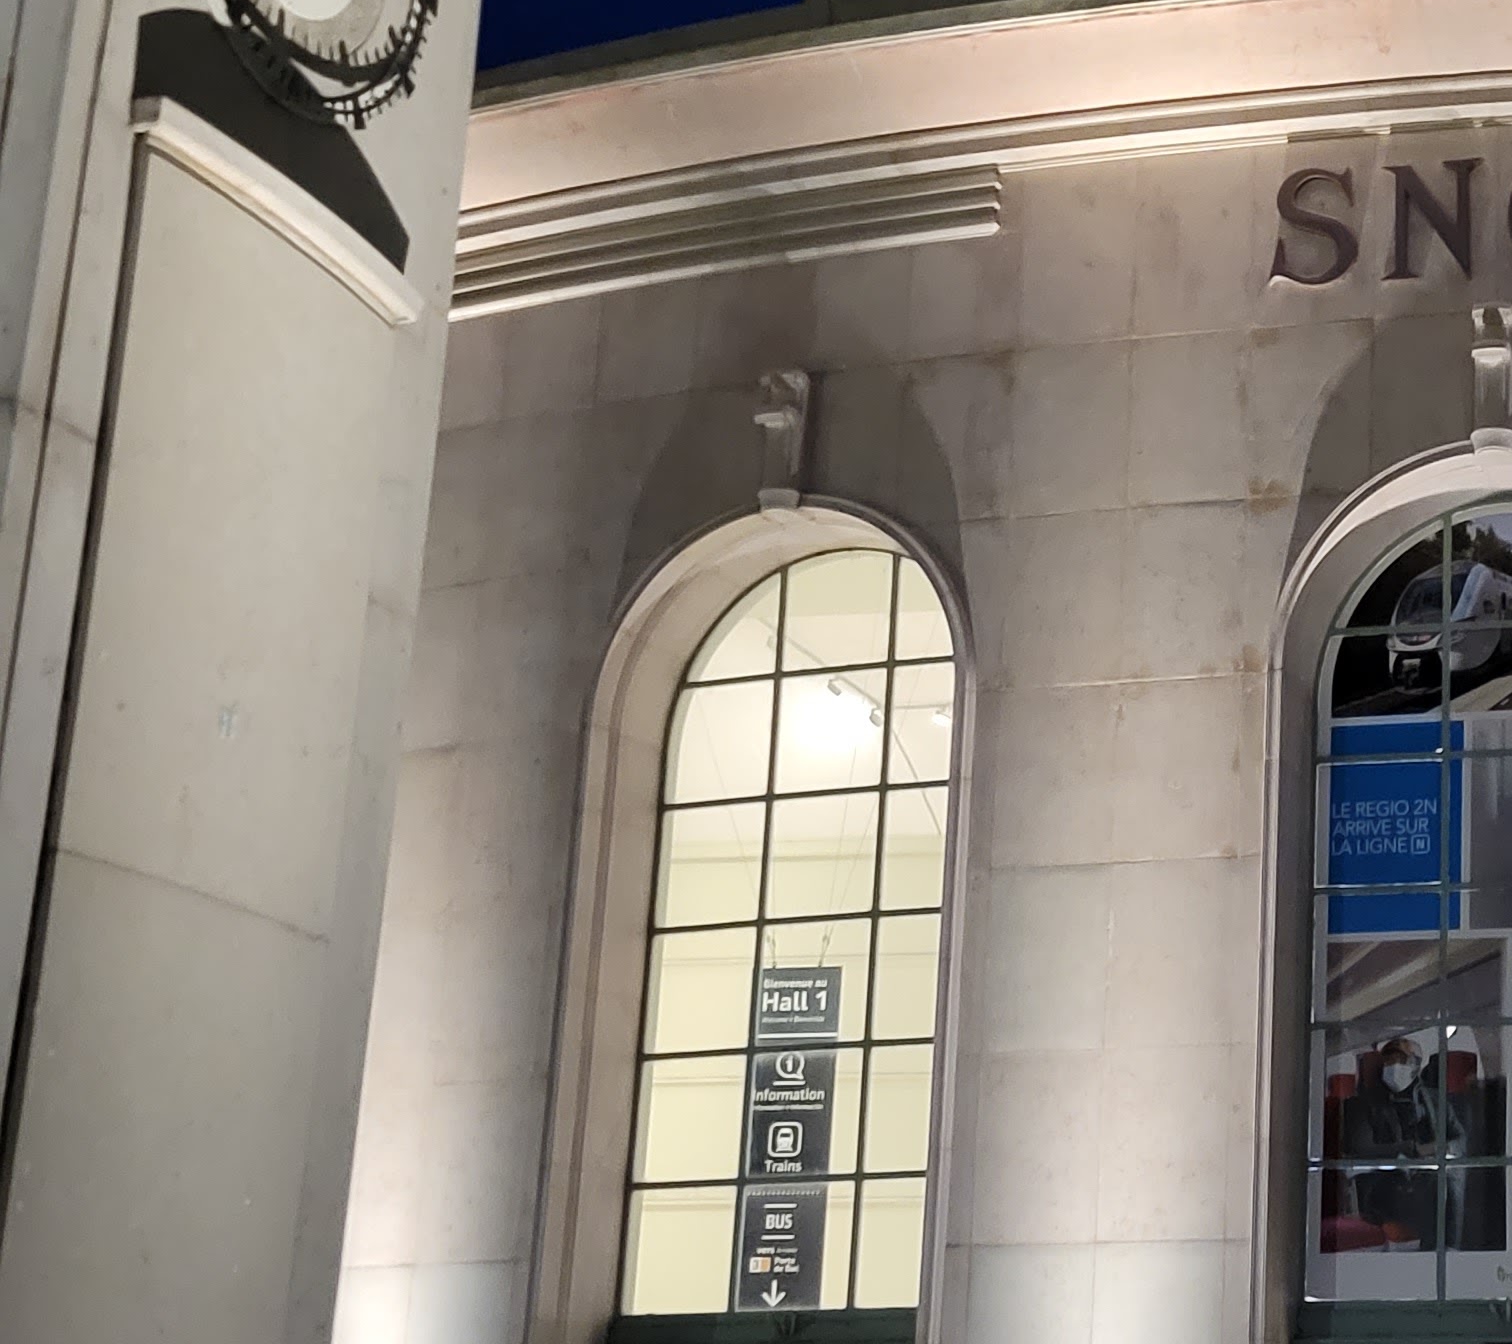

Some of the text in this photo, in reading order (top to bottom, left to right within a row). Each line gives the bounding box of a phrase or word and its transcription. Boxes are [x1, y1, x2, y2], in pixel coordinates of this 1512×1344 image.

[1332, 798, 1437, 818] LE REGIO 2N
[1332, 817, 1429, 837] ARRIVE SUR
[1332, 838, 1352, 855] LA
[1357, 837, 1408, 855] LIGNE
[762, 990, 828, 1013] Hall 1
[753, 1088, 826, 1102] Information
[764, 1159, 802, 1173] Trains
[765, 1213, 793, 1230] BUS
